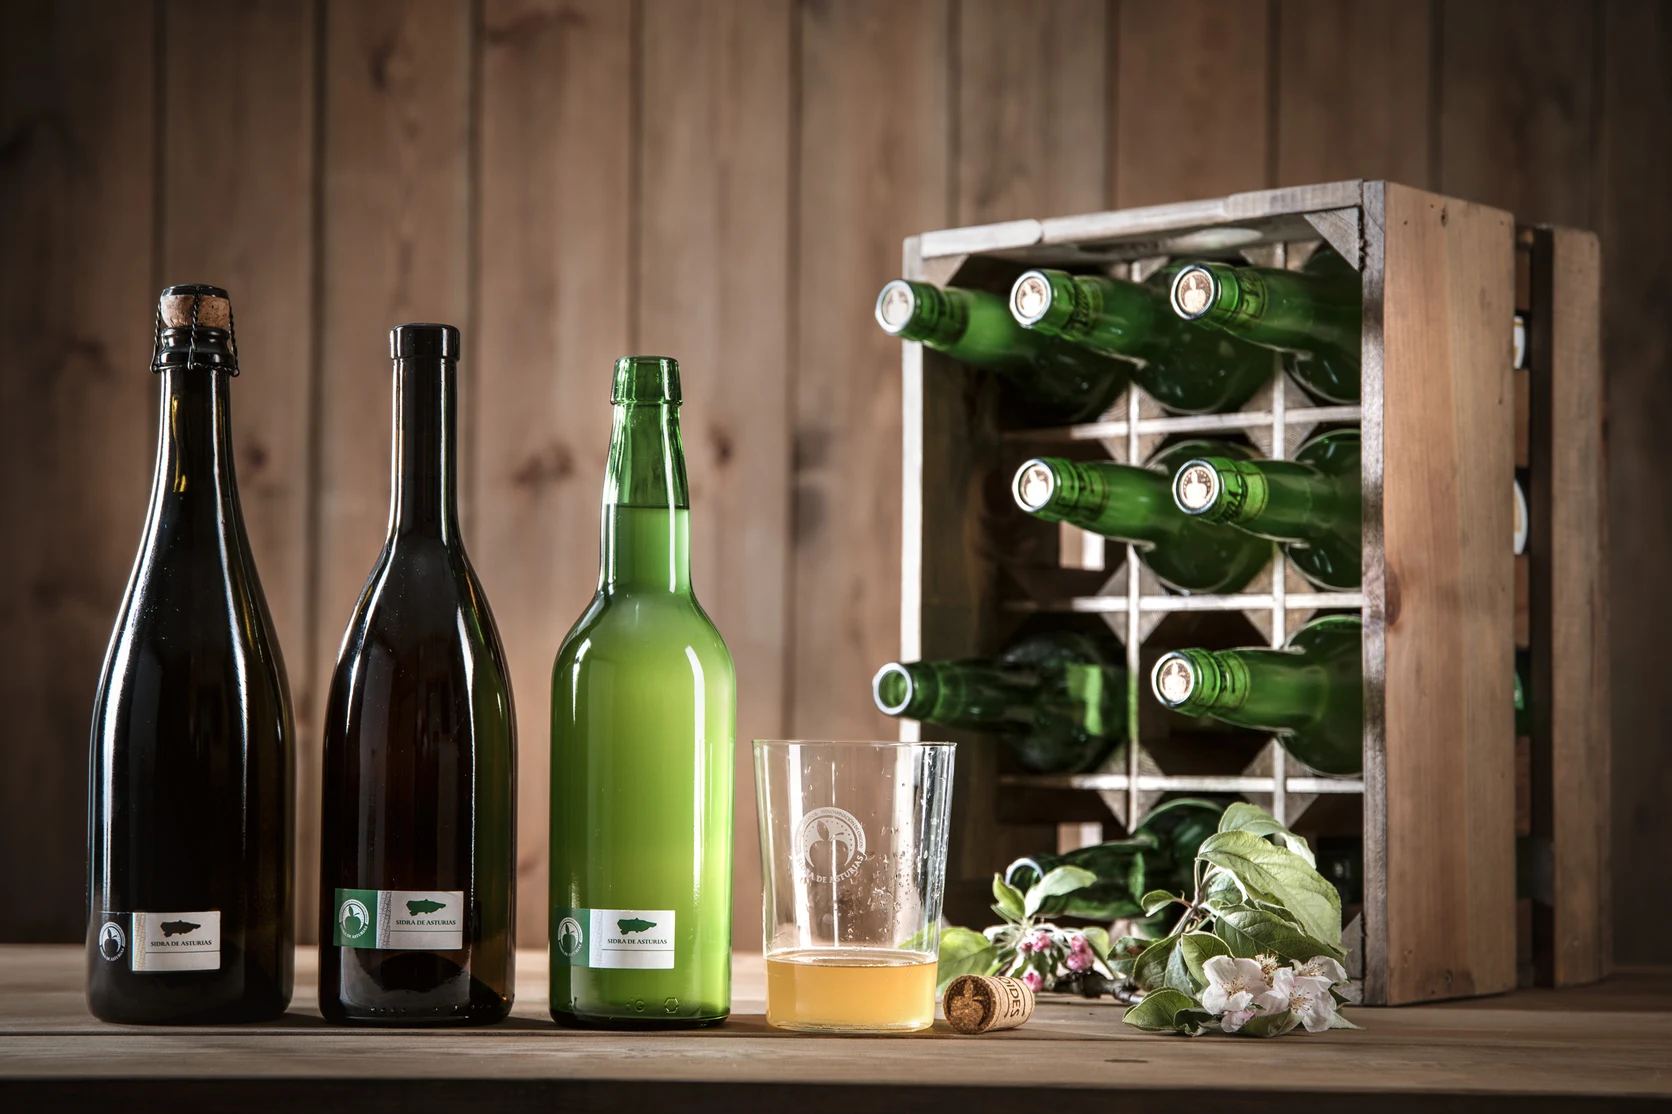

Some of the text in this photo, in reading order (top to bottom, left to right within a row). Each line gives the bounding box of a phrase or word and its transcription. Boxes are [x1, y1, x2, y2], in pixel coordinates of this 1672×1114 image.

[816, 875, 827, 883] DE
[829, 854, 864, 883] ASTURIAS
[180, 939, 212, 947] ASTURIAS
